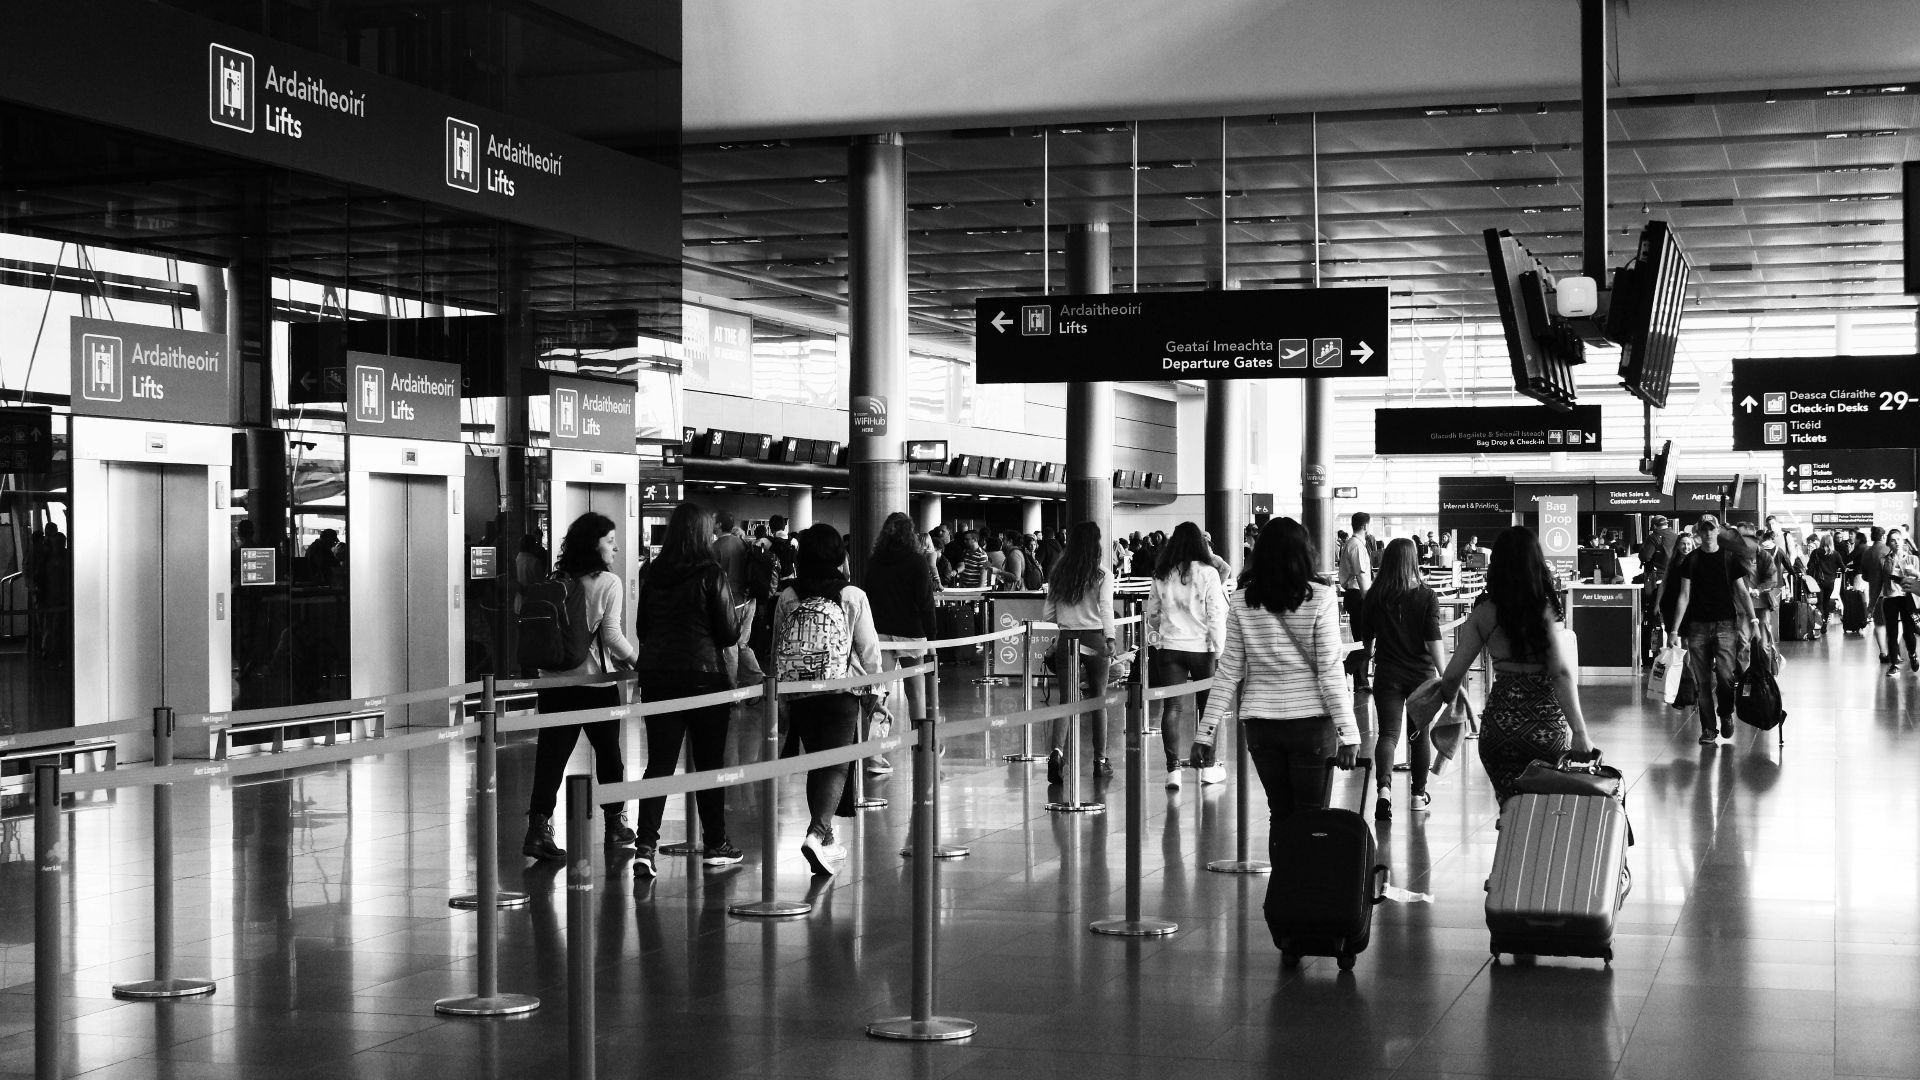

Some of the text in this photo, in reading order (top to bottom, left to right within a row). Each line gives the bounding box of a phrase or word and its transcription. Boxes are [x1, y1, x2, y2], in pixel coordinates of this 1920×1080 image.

[265, 65, 365, 117] Ardaitheoirí
[266, 104, 302, 138] Lifts
[487, 134, 562, 176] Ardaitheoirí
[488, 168, 514, 196] Lifts
[1060, 302, 1142, 317] Ardaitheoirí
[1059, 321, 1087, 335] Lifts
[1166, 339, 1273, 353] Geataí Imeachta
[132, 343, 219, 372] Ardaitheoirí
[1162, 356, 1273, 372] Departure Gates
[132, 375, 164, 399] Lifts
[391, 373, 455, 397] Ardaitheoirí
[1790, 389, 1876, 399] Deasca Cláraithe
[391, 400, 415, 420] Lifts
[583, 394, 631, 414] Ardaitheoirí
[1790, 404, 1869, 413] Check-in Desks
[583, 418, 600, 435] Lifts
[1790, 420, 1821, 429] Ticéid
[685, 430, 694, 443] 37
[712, 432, 722, 444] 38
[762, 437, 771, 449] 39
[1790, 434, 1827, 443] Tickets
[1859, 479, 1896, 489] 29-56
[1706, 493, 1730, 502] Lings
[1475, 503, 1499, 511] Printing
[1546, 502, 1566, 513] Bag
[1545, 514, 1572, 525] Drop
[1594, 594, 1614, 602] Lingus
[193, 766, 221, 776] Aer Lingus
